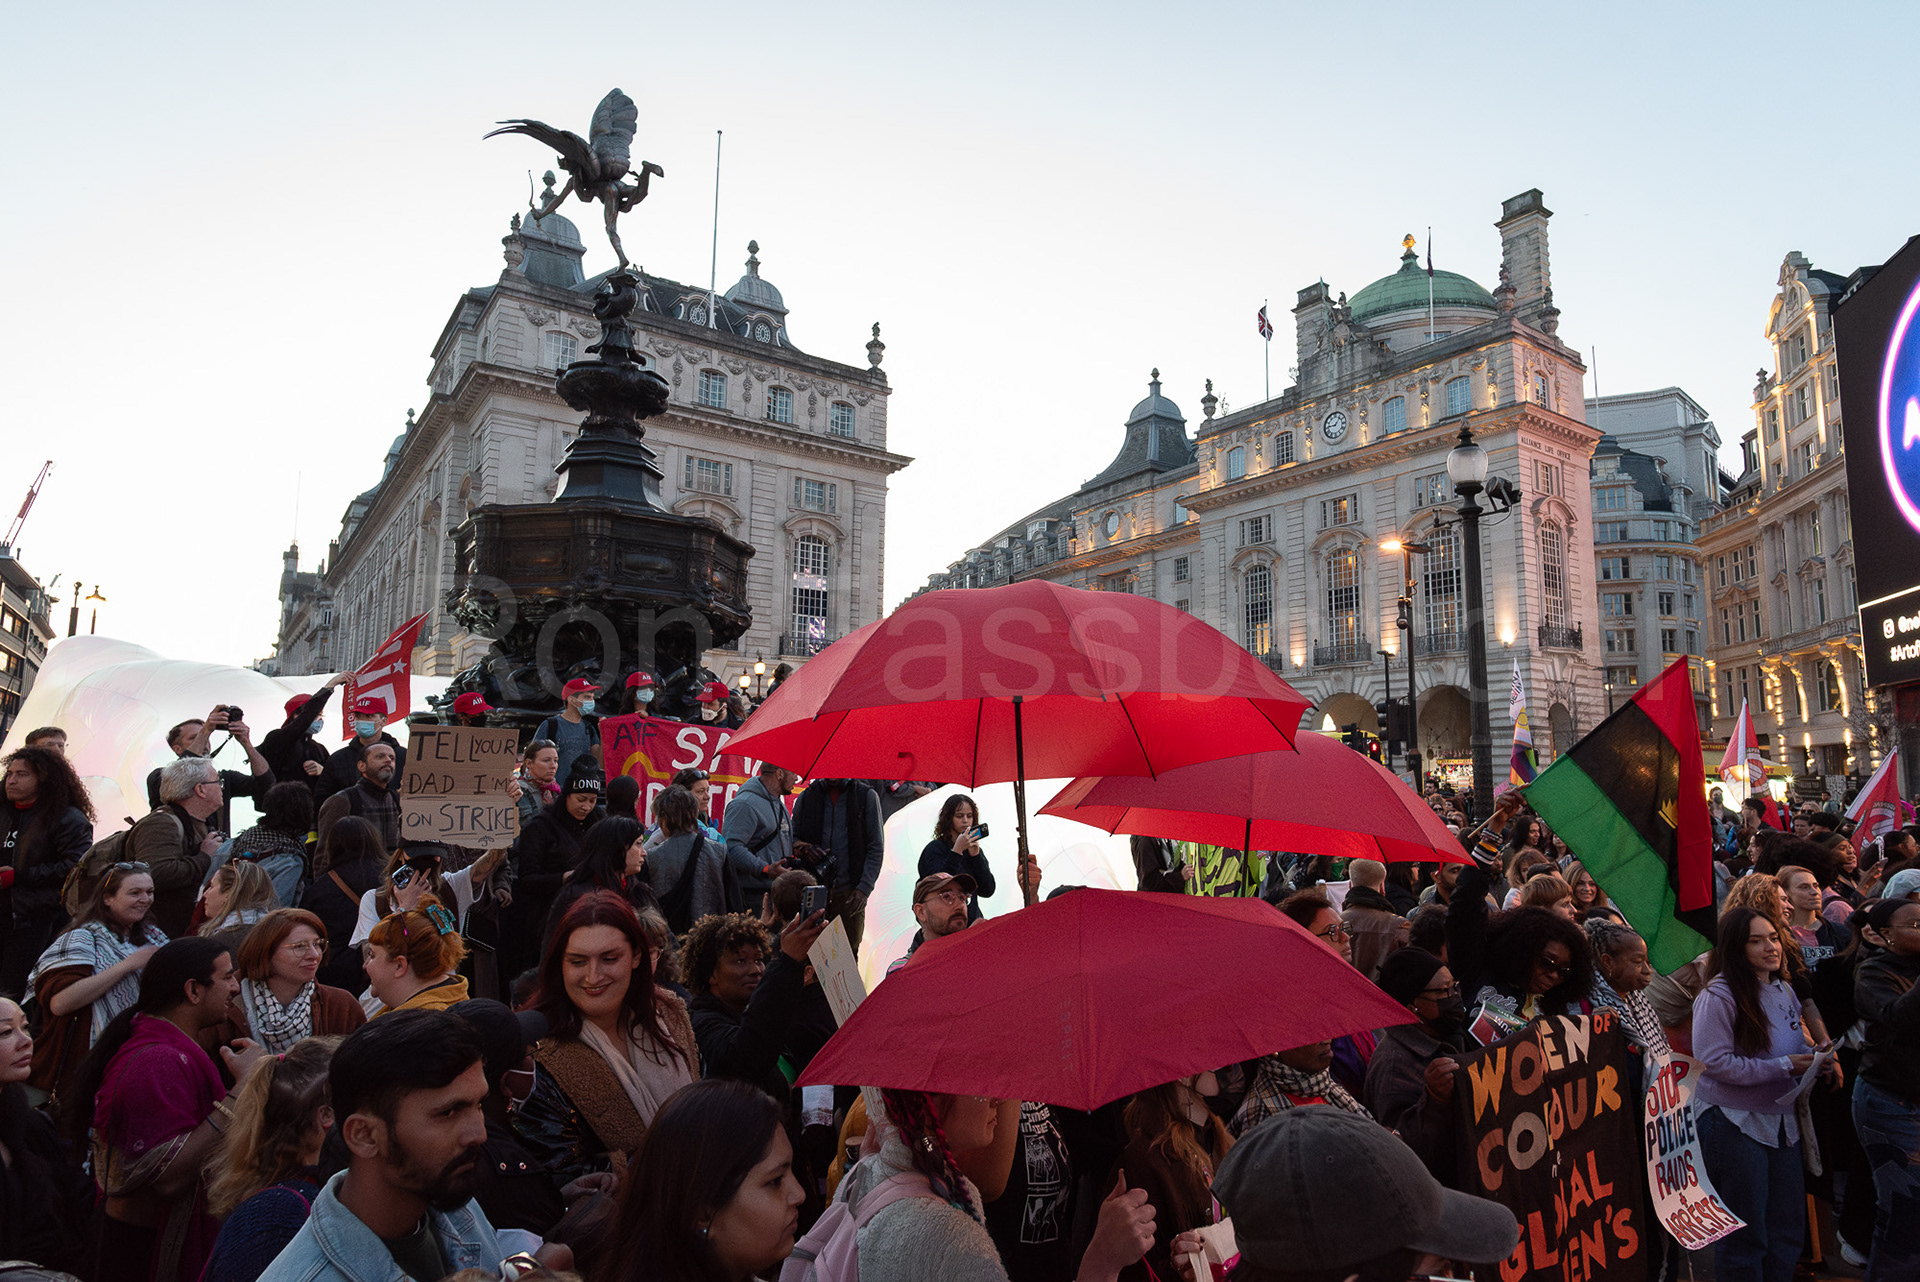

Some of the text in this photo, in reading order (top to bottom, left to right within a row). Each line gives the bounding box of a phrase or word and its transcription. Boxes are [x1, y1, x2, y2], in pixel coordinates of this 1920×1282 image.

[1521, 436, 1571, 461] ALLIANCE LIFE OFFICE
[347, 704, 357, 732] FONT
[411, 731, 516, 763] TELL YOUR
[408, 772, 508, 795] DAD I'M
[572, 778, 601, 791] LOND
[406, 803, 515, 832] ON STRIKE
[1804, 947, 1835, 958] BORDE
[1467, 1013, 1611, 1127] WOEN OF
[1647, 1060, 1690, 1117] STOP
[1646, 1105, 1696, 1162] POLICE
[1655, 1149, 1698, 1201] RAIDS
[1500, 1150, 1614, 1281] GLAL
[1665, 1194, 1739, 1247] ARRESTS
